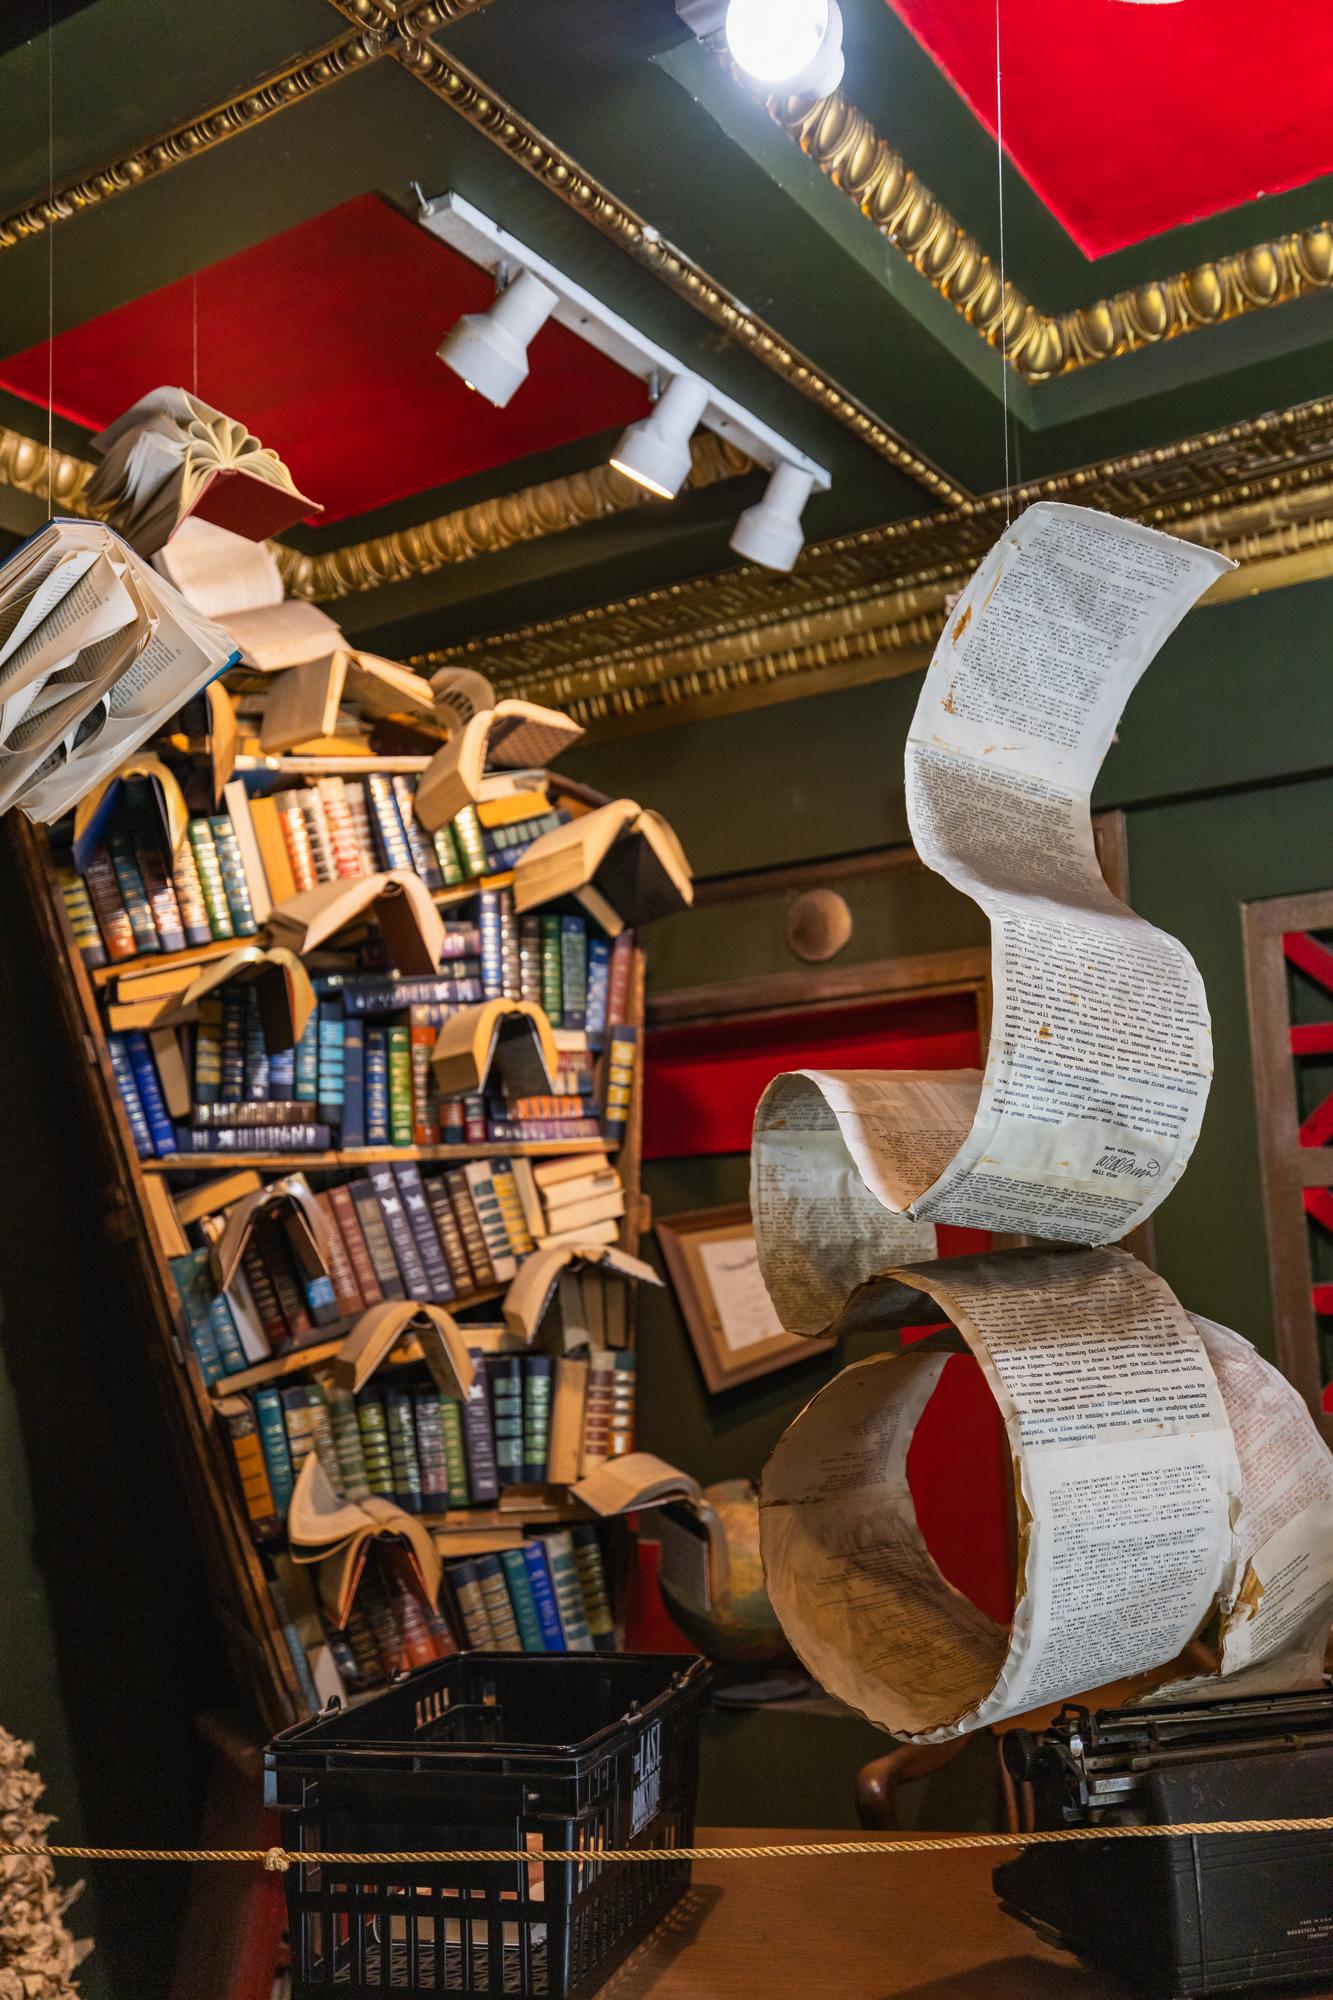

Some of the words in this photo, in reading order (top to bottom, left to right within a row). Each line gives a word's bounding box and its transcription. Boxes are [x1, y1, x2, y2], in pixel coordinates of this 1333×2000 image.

[1006, 1060, 1033, 1070] character
[1056, 1070, 1070, 1078] those
[1019, 1072, 1031, 1081] hope
[1092, 1088, 1107, 1096] gives
[1120, 1095, 1143, 1105] something
[1036, 1086, 1054, 1094] looked
[1070, 1092, 1084, 1100] local
[1004, 1090, 1029, 1099] assistant
[1087, 1106, 1114, 1116] available,
[1116, 1111, 1128, 1120] keep
[1138, 1115, 1159, 1126] studying
[1113, 1119, 1130, 1127] video.
[1153, 1127, 1167, 1135] touch
[1076, 1374, 1100, 1382] thinking
[1102, 1372, 1116, 1380] about
[1130, 1369, 1153, 1377] attitude
[1182, 1365, 1203, 1373] building
[1015, 1389, 1041, 1397] character
[1107, 1389, 1121, 1398] gives
[1027, 1415, 1054, 1424] assistant
[1111, 1407, 1140, 1415] available,
[1142, 1406, 1154, 1414] keep
[1165, 1403, 1187, 1412] studying
[1057, 1402, 1075, 1410] looked
[1041, 1436, 1055, 1445] great
[640, 1721, 662, 1781] LAST
